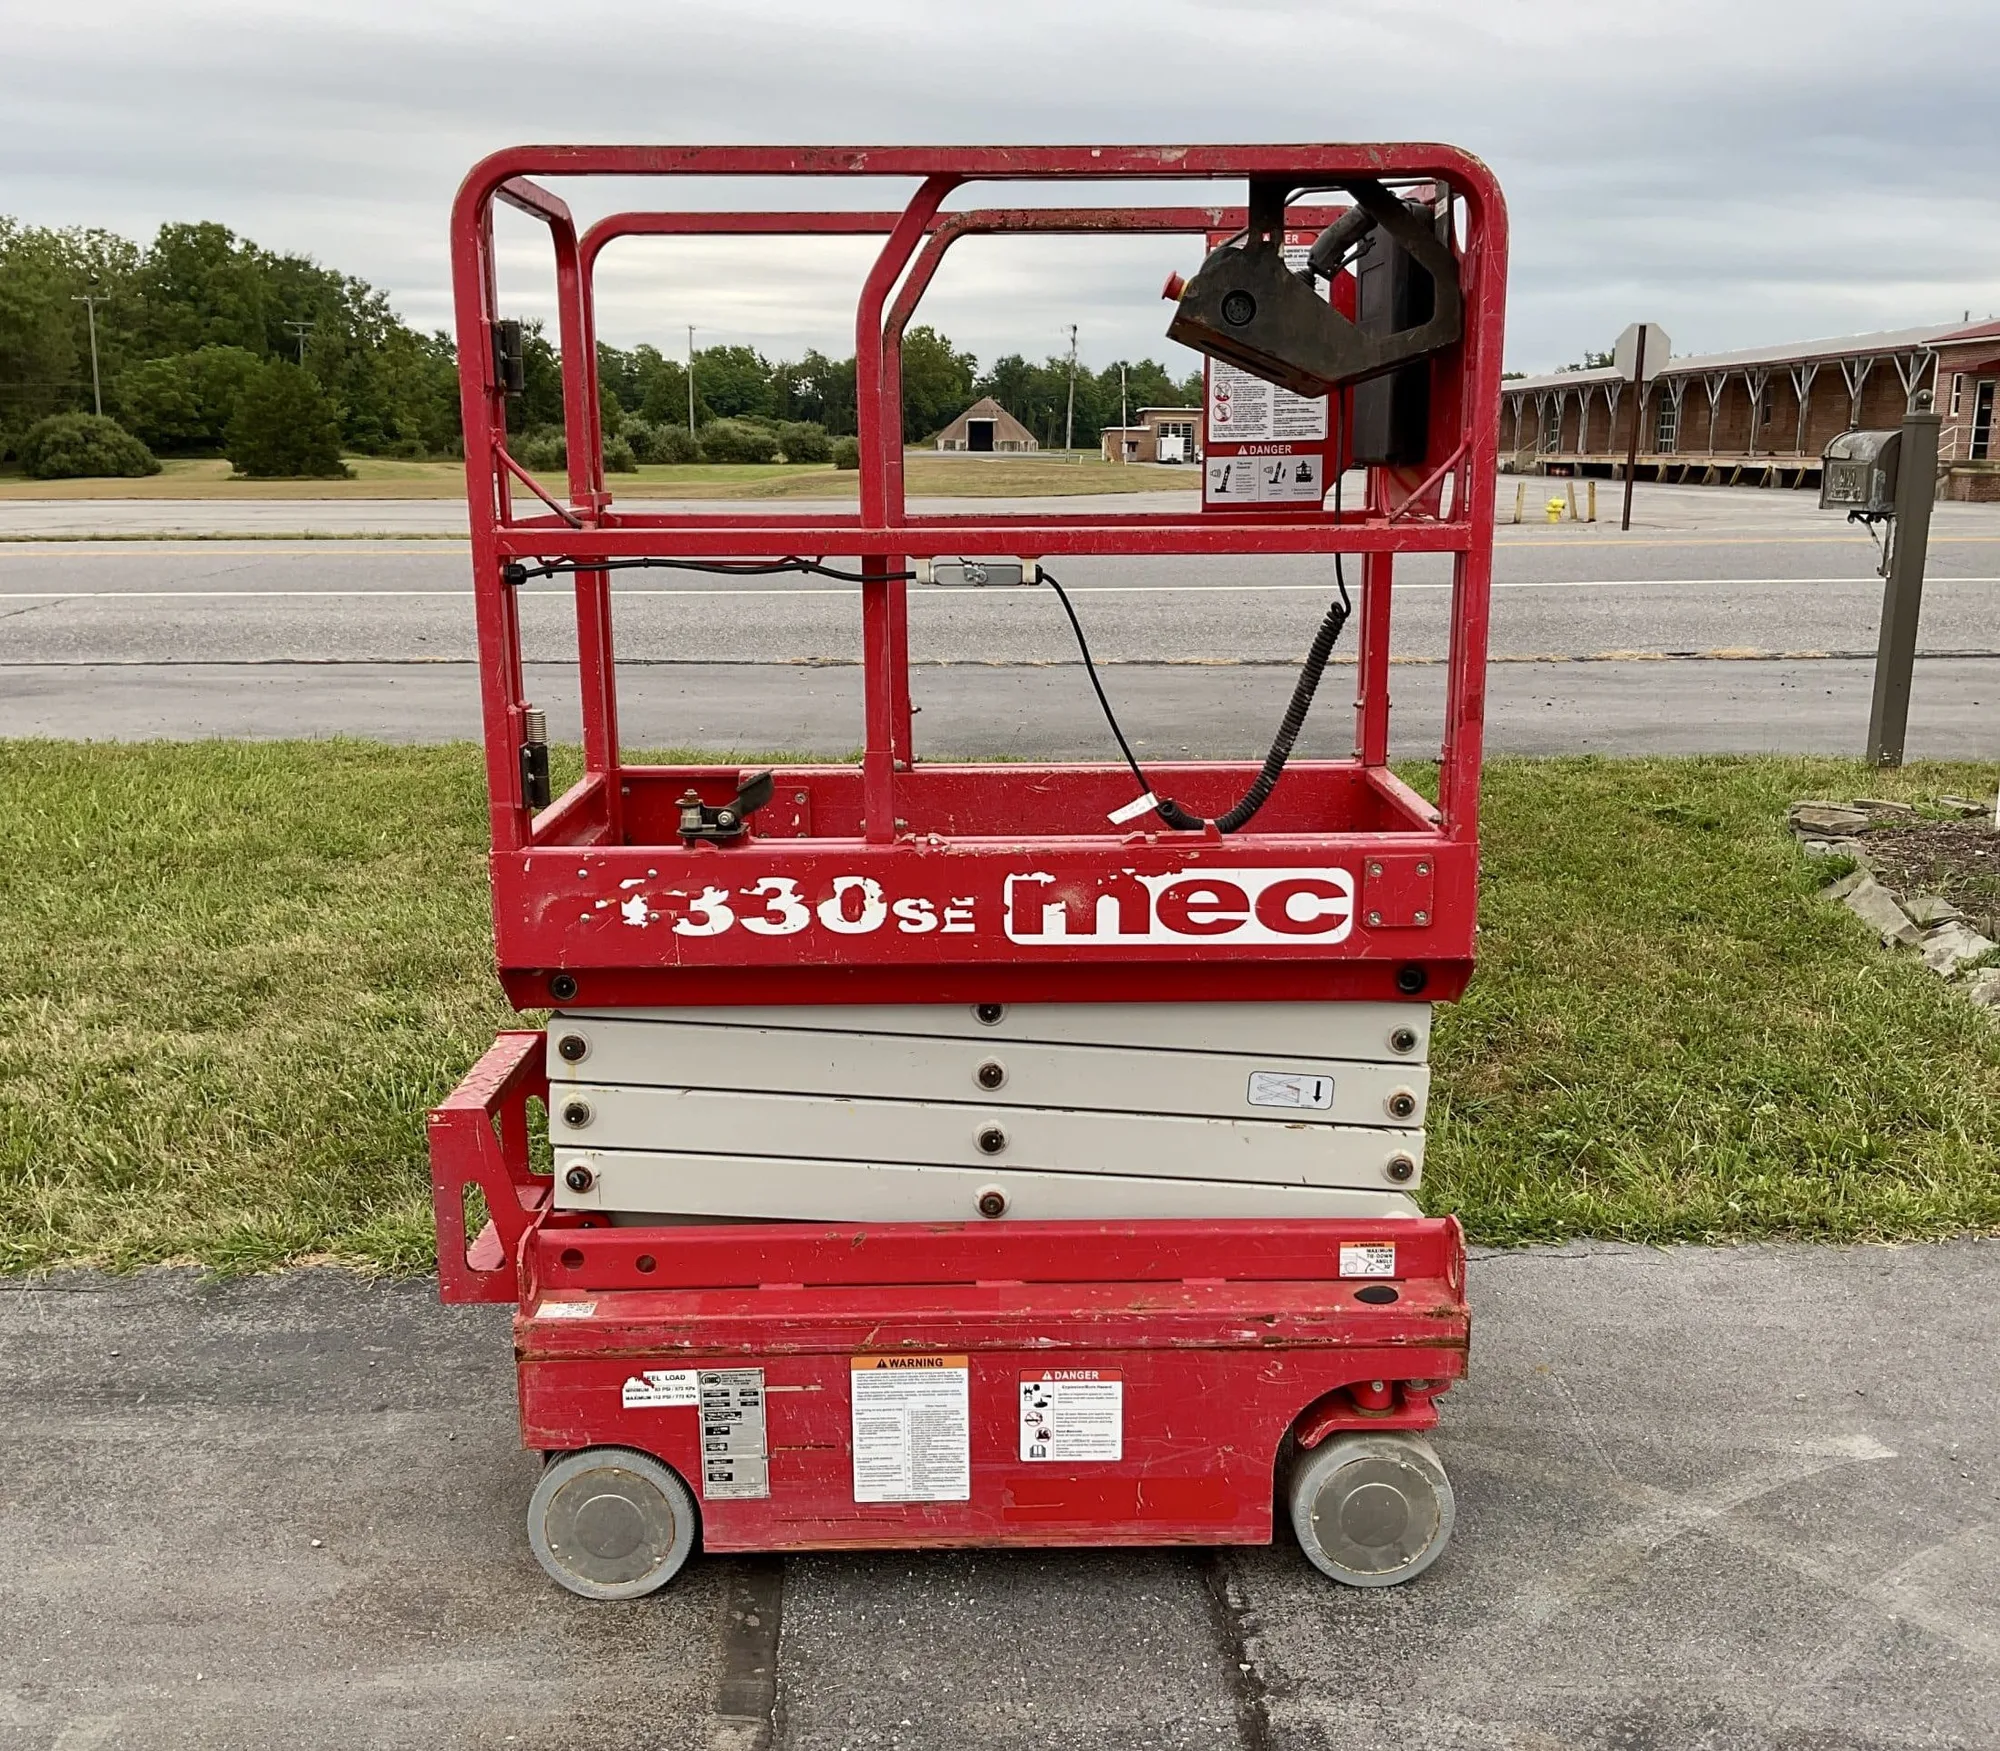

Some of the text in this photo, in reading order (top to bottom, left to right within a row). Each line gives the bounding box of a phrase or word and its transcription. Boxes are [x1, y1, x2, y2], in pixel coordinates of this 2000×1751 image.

[1249, 444, 1292, 455] DANGER
[1011, 878, 1350, 936] mec
[889, 1358, 943, 1368] WARNING
[1054, 1371, 1099, 1380] DANGER
